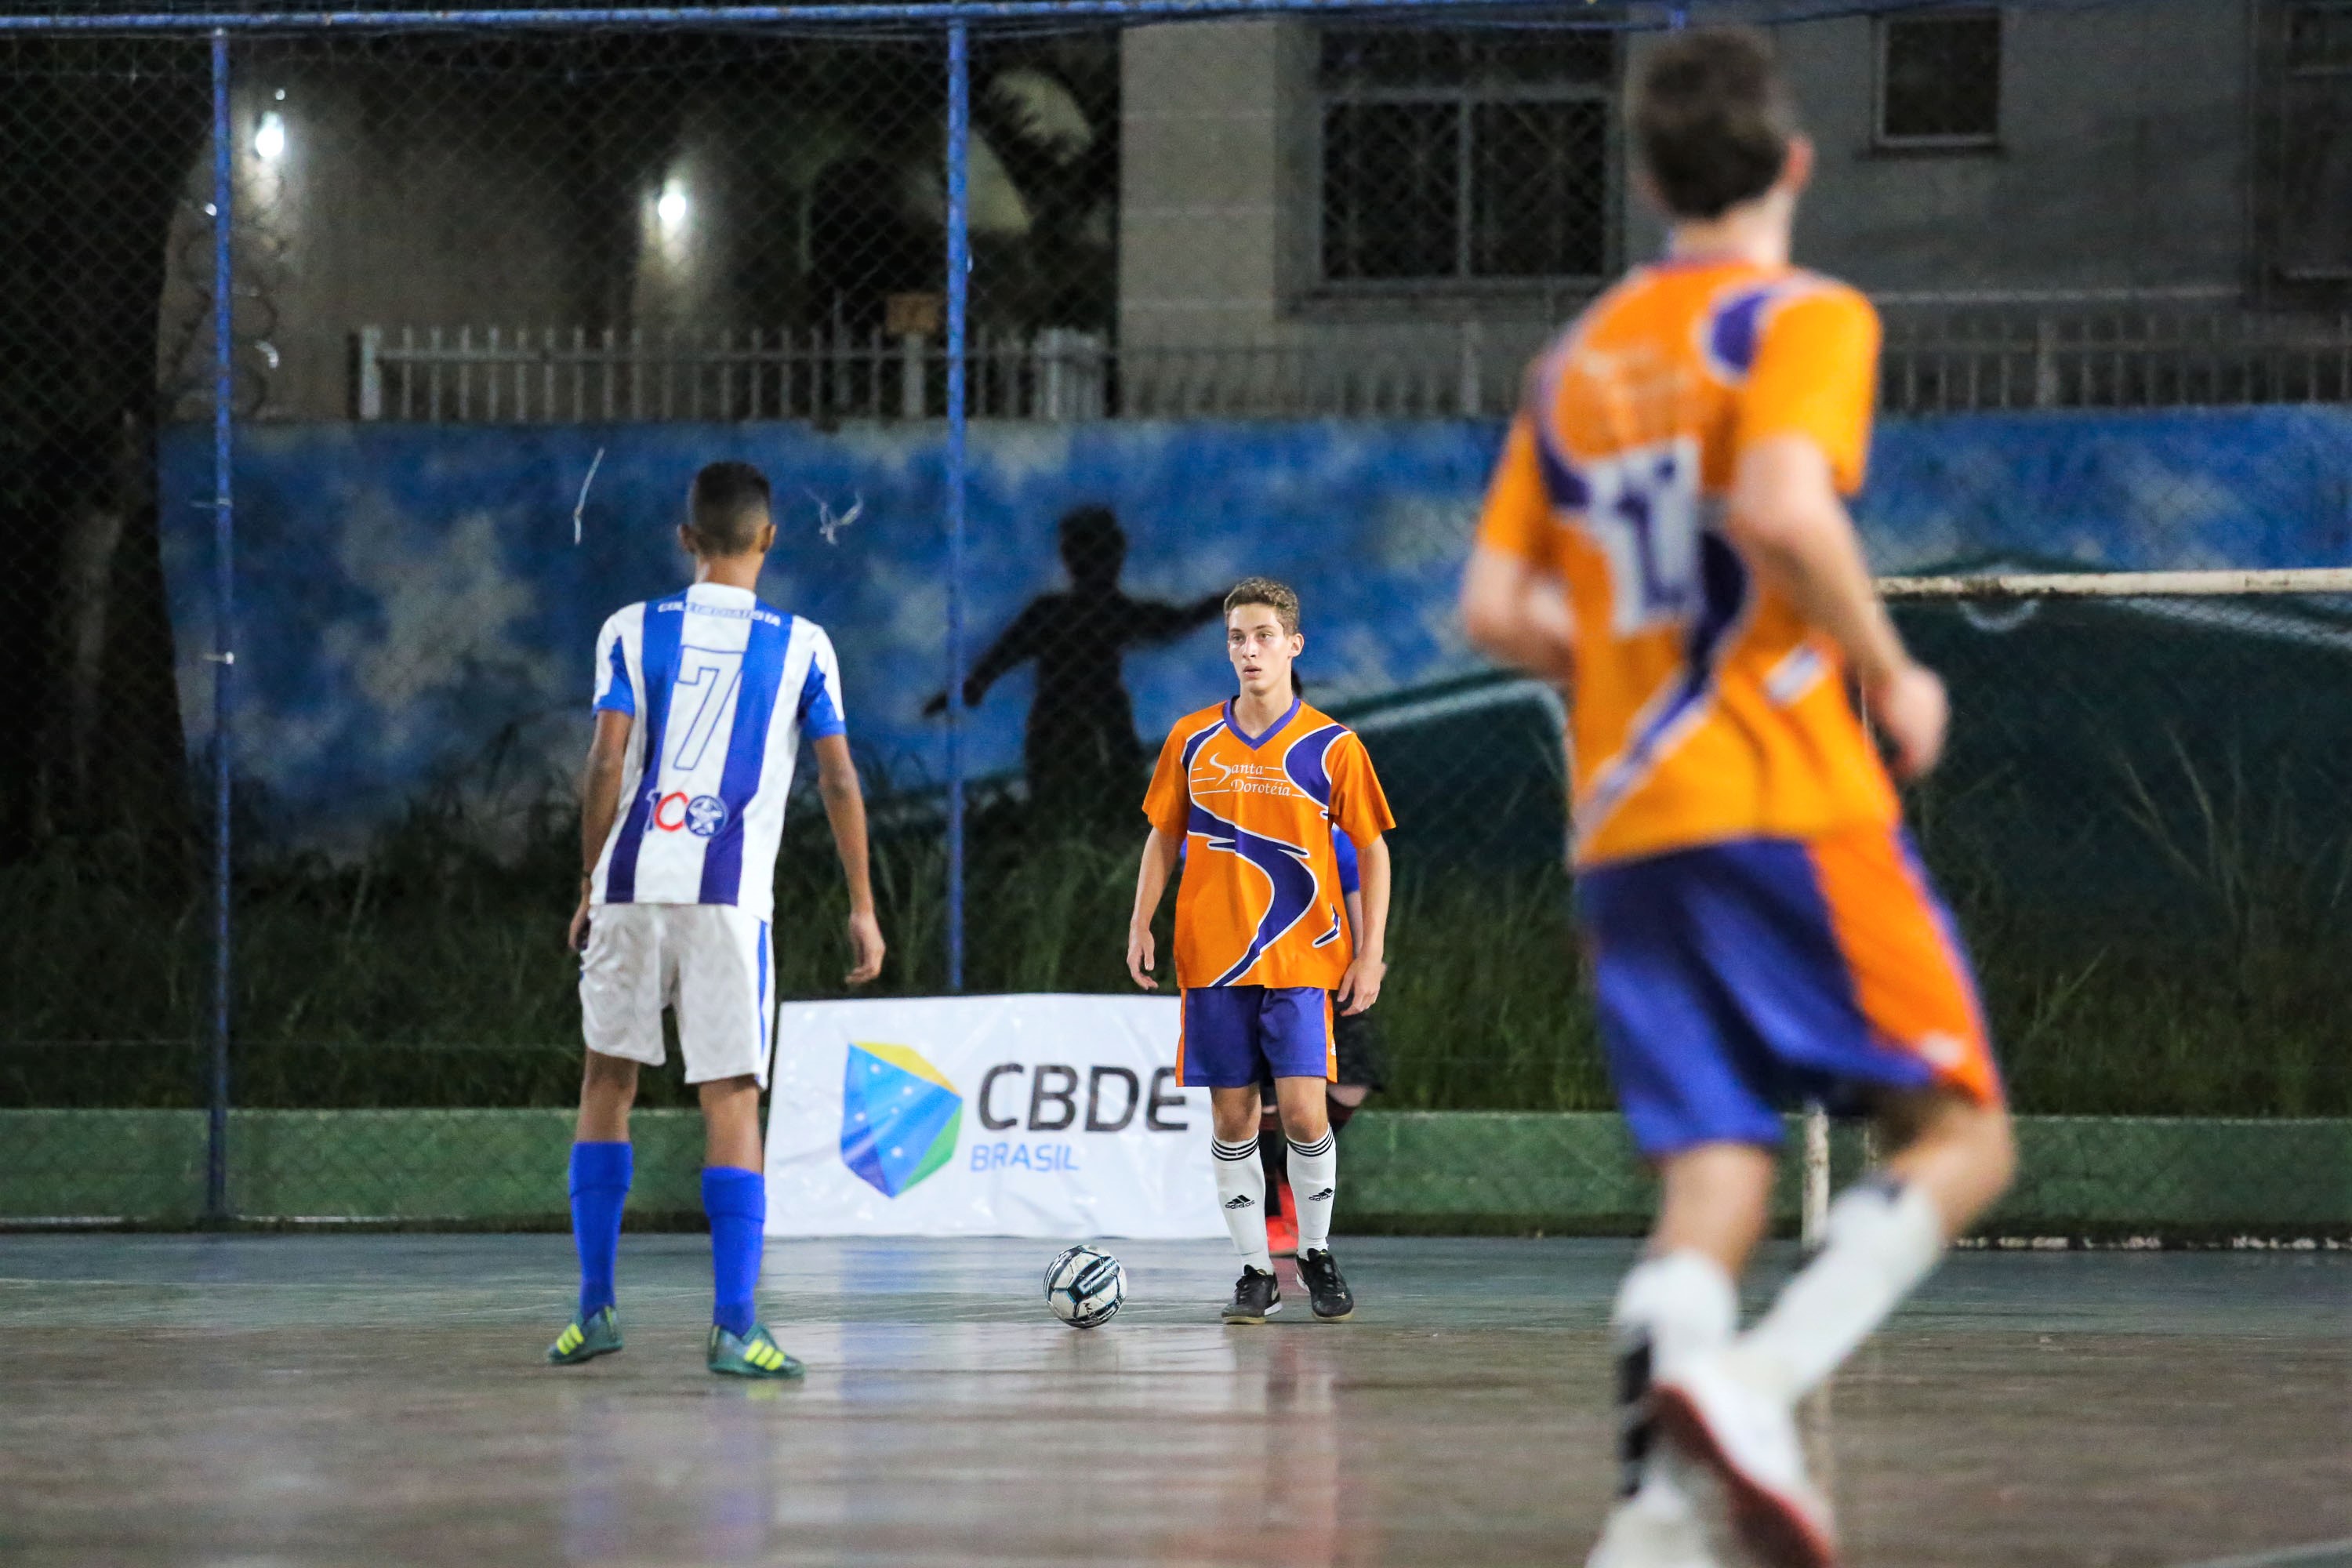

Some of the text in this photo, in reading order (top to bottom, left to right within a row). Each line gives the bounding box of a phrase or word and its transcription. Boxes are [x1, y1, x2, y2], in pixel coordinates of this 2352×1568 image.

[673, 644, 744, 771] 7
[1209, 751, 1264, 786] Santa
[1230, 778, 1291, 797] Dorotéia
[977, 1062, 1190, 1133] CBDE
[969, 1141, 1080, 1173] BRASIL
[1225, 1200, 1255, 1209] adidas
